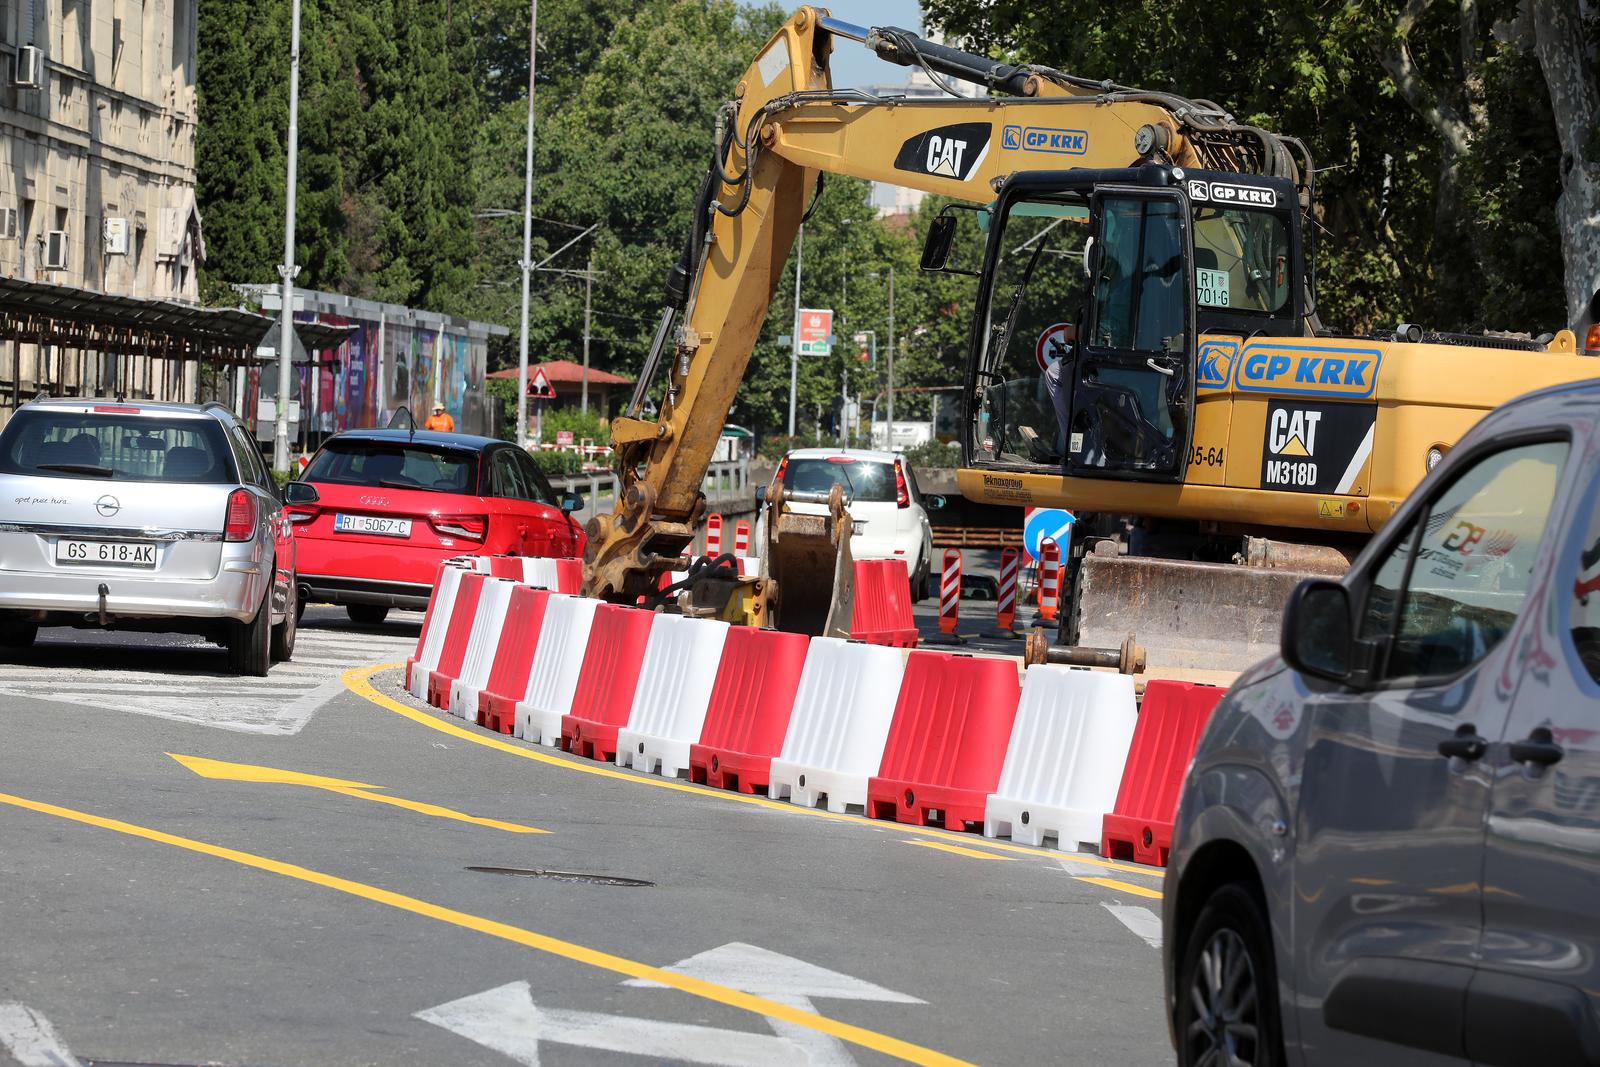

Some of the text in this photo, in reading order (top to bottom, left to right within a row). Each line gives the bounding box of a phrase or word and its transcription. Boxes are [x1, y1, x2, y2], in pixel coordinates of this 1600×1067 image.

[1026, 132, 1048, 147] GP
[1050, 134, 1084, 150] KRK
[926, 135, 967, 178] CAT
[1213, 187, 1236, 200] GP
[1238, 189, 1272, 203] KRK
[1201, 272, 1214, 287] RI
[1244, 353, 1291, 381] GP
[1294, 357, 1372, 386] KRK
[1269, 408, 1322, 457] CAT
[1266, 460, 1318, 486] M318D
[343, 516, 406, 534] RI 5067-C
[67, 542, 153, 562] GS 618-AK
